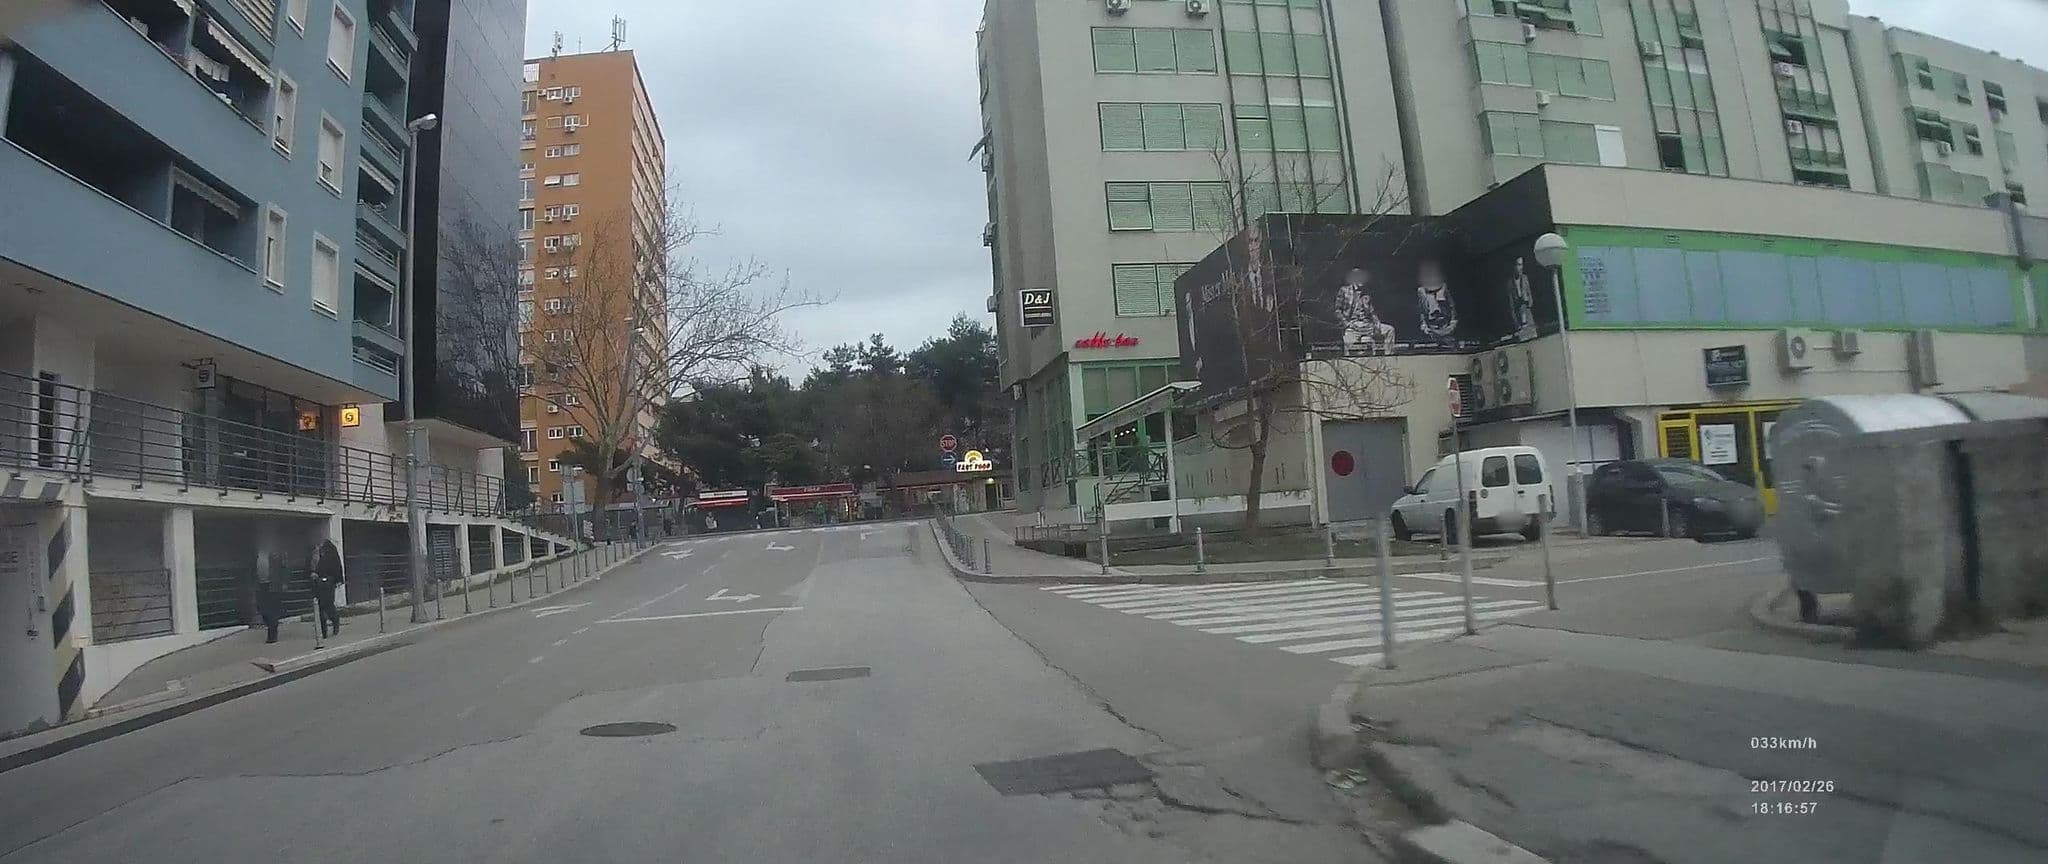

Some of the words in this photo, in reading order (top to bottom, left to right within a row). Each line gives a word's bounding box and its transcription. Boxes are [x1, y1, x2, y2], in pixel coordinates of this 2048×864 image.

[1024, 292, 1050, 305] D&J
[957, 463, 973, 471] FAST
[975, 462, 991, 470] FOOD
